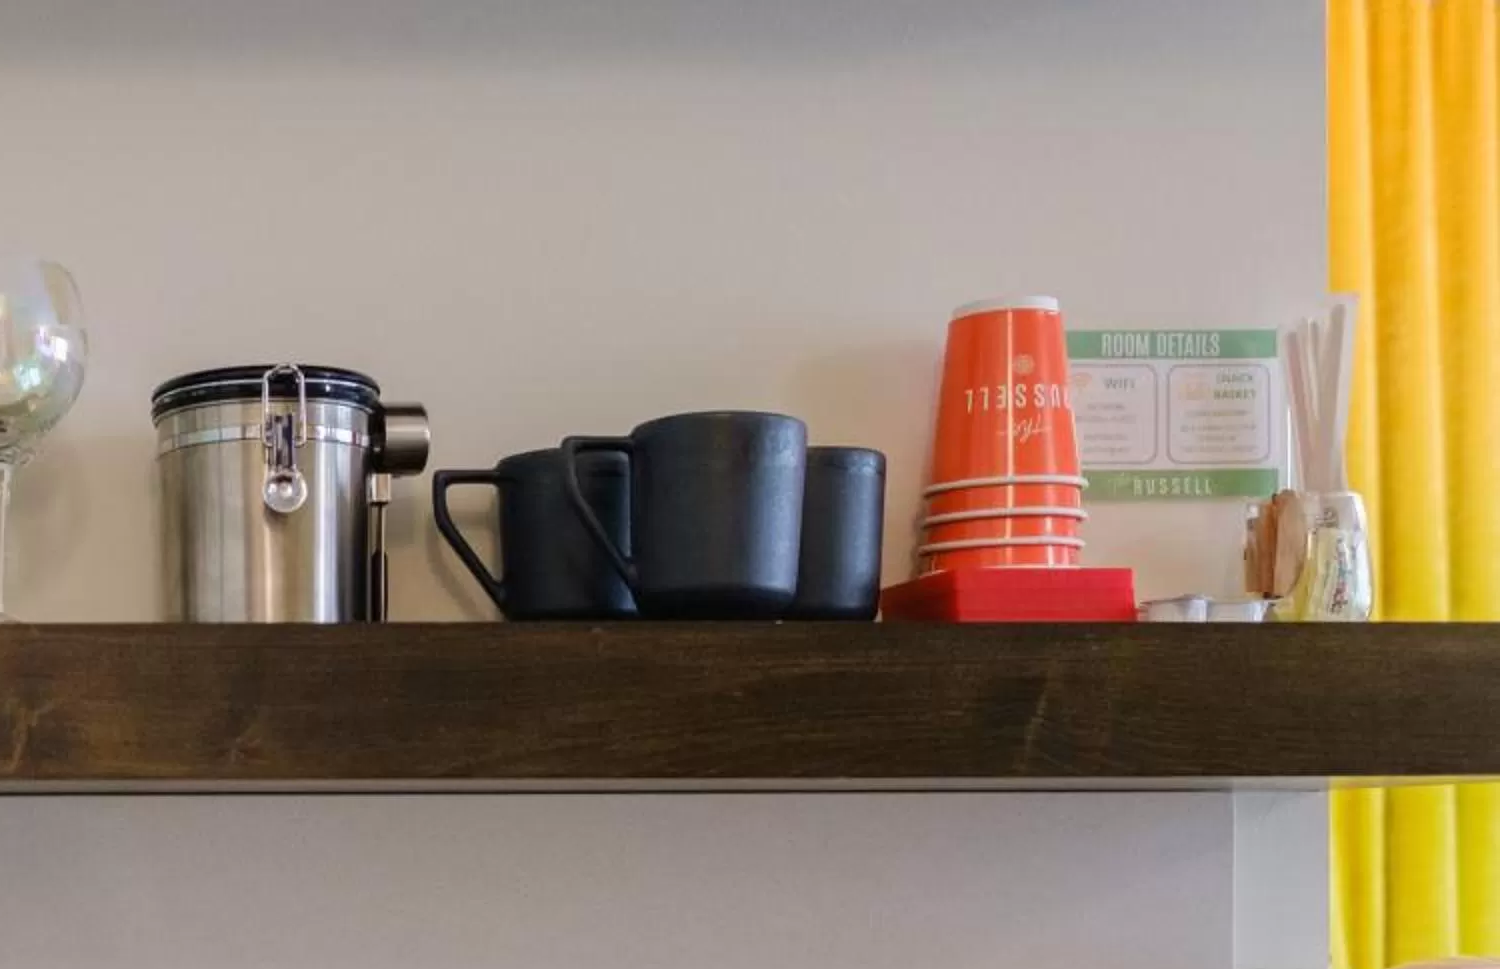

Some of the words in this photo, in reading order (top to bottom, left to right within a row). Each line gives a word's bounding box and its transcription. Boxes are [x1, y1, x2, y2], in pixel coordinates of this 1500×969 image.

[1101, 332, 1150, 357] ROOM
[1157, 332, 1220, 357] DETAILS
[1133, 476, 1212, 496] RUSSELL
